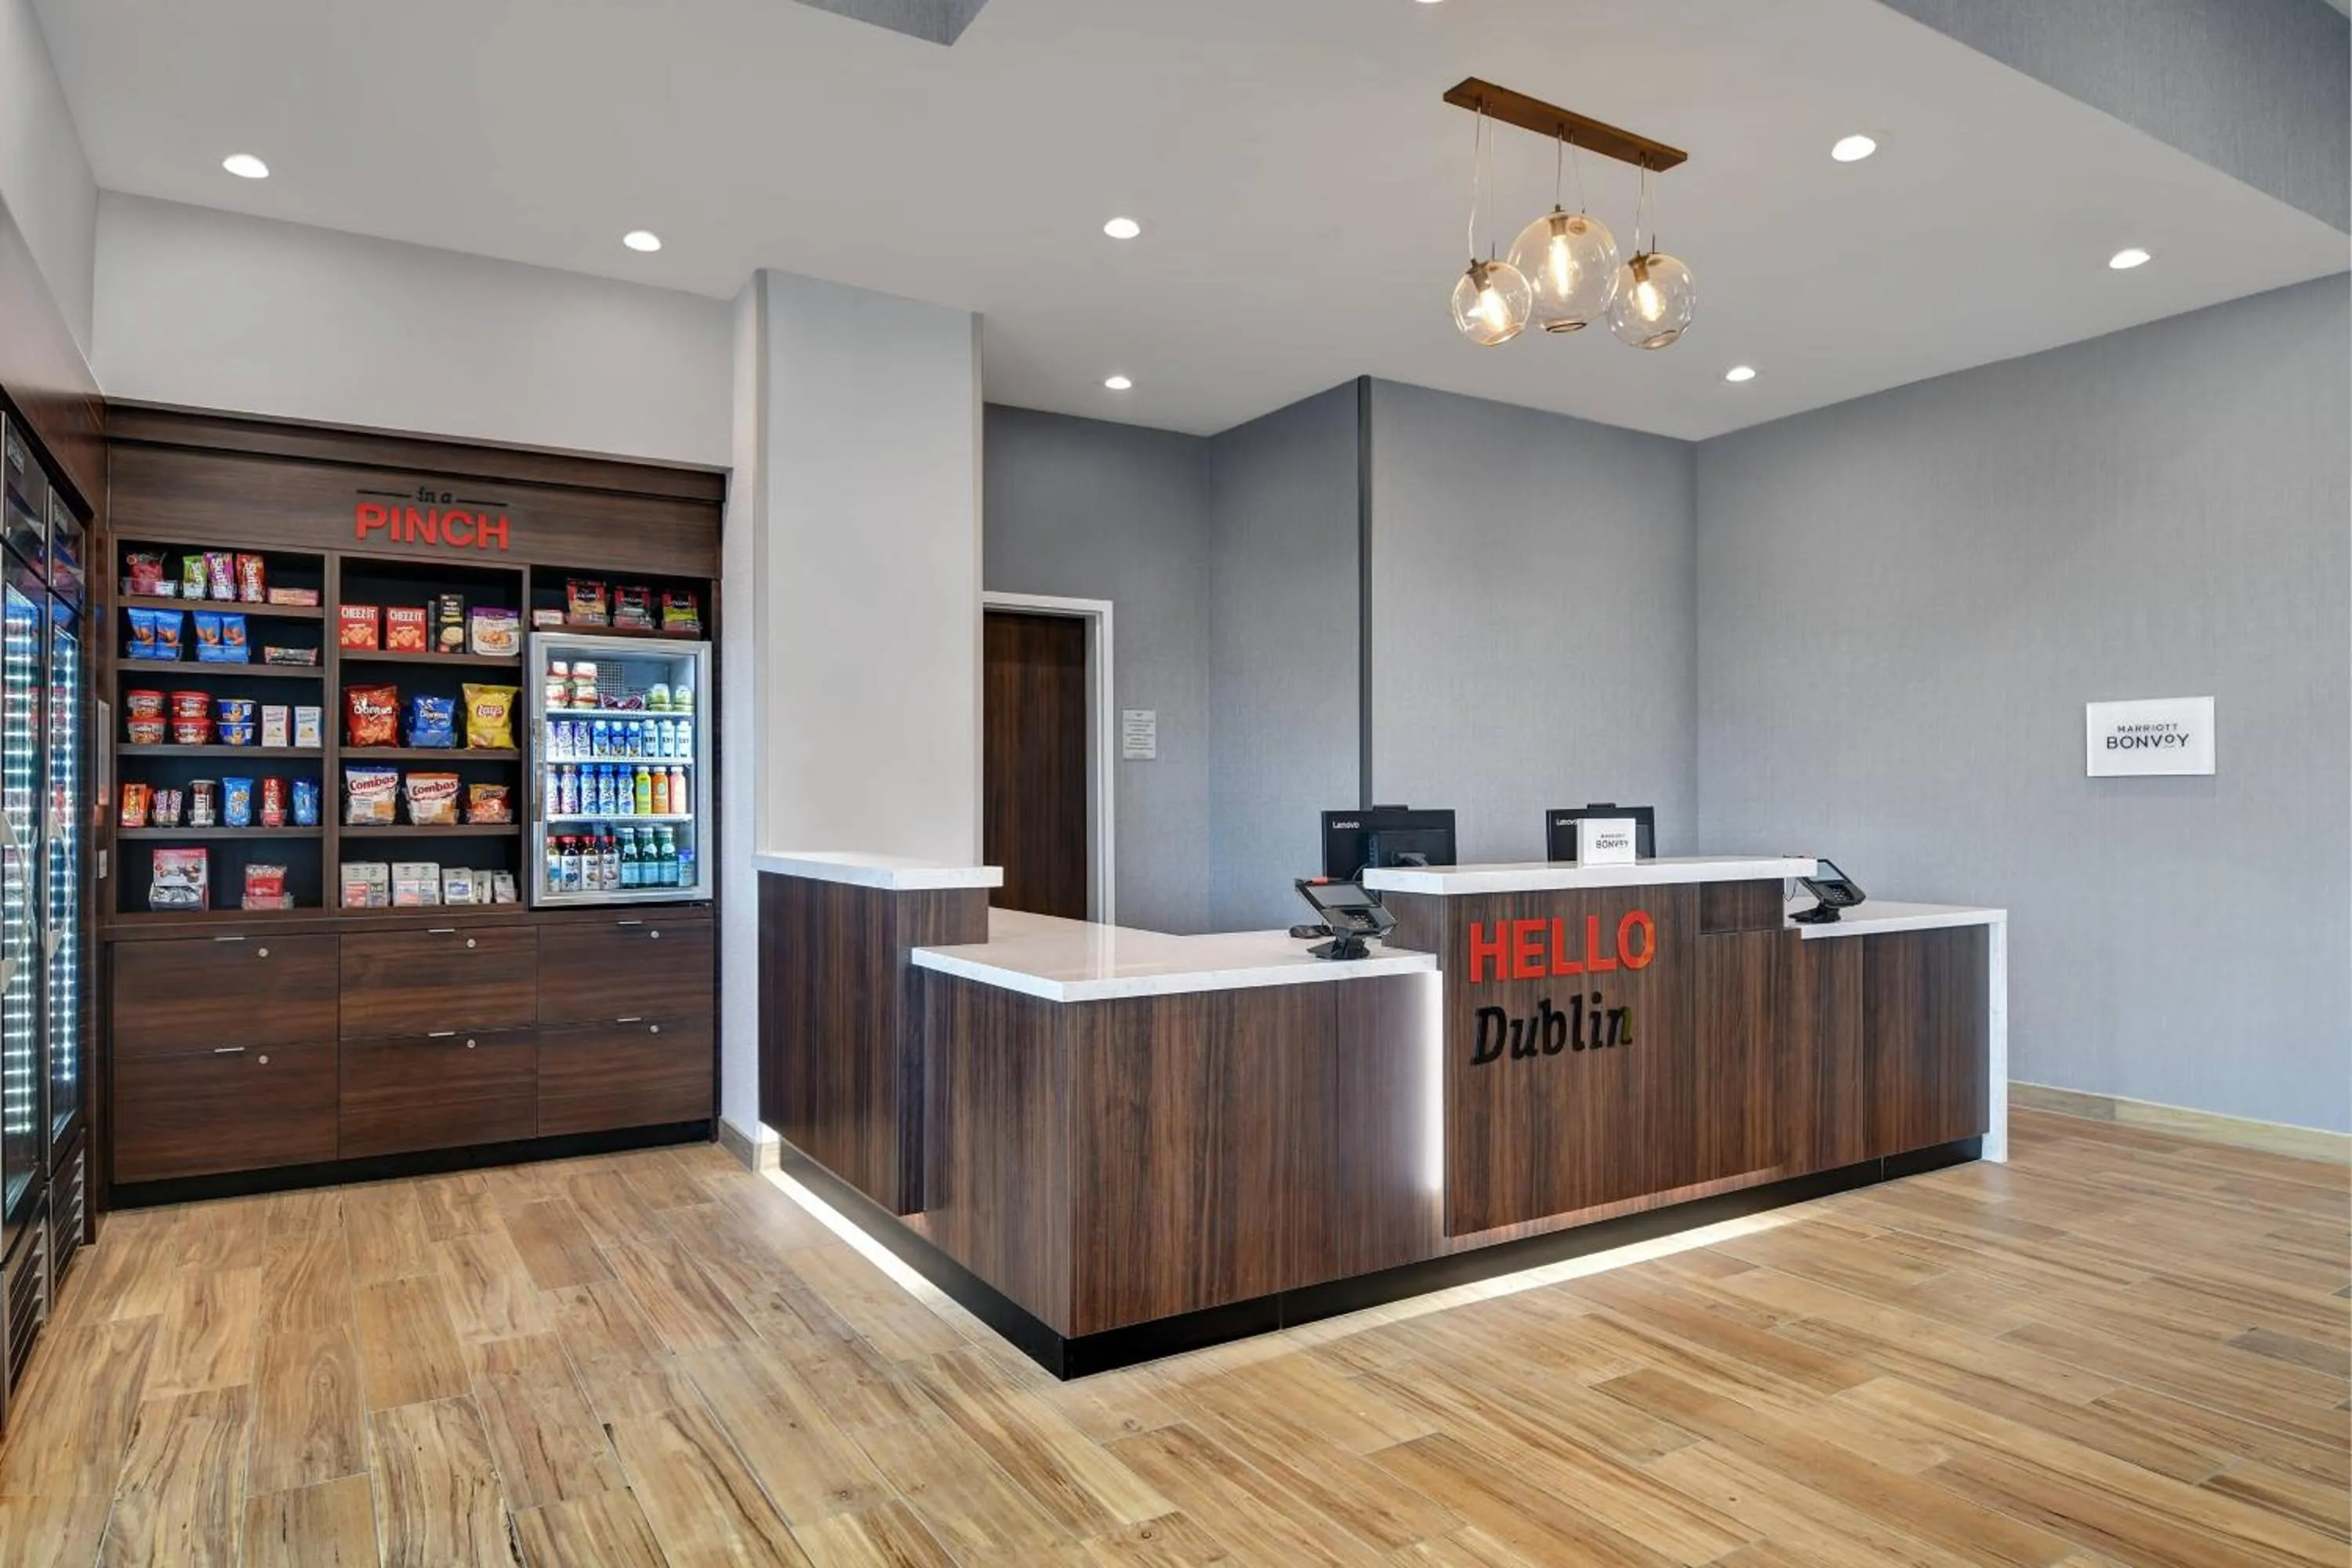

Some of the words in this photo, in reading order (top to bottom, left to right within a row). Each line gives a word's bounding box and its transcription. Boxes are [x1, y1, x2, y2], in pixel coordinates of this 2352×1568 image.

[416, 487, 436, 503] in
[441, 492, 453, 503] a
[355, 503, 510, 550] PINCH
[2117, 724, 2178, 733] MARRIOTT
[2107, 734, 2189, 750] BONVOY
[350, 775, 396, 790] Combos
[412, 781, 456, 796] Combos
[1469, 910, 1656, 984] HELLO
[1470, 991, 1632, 1066] Dublin
